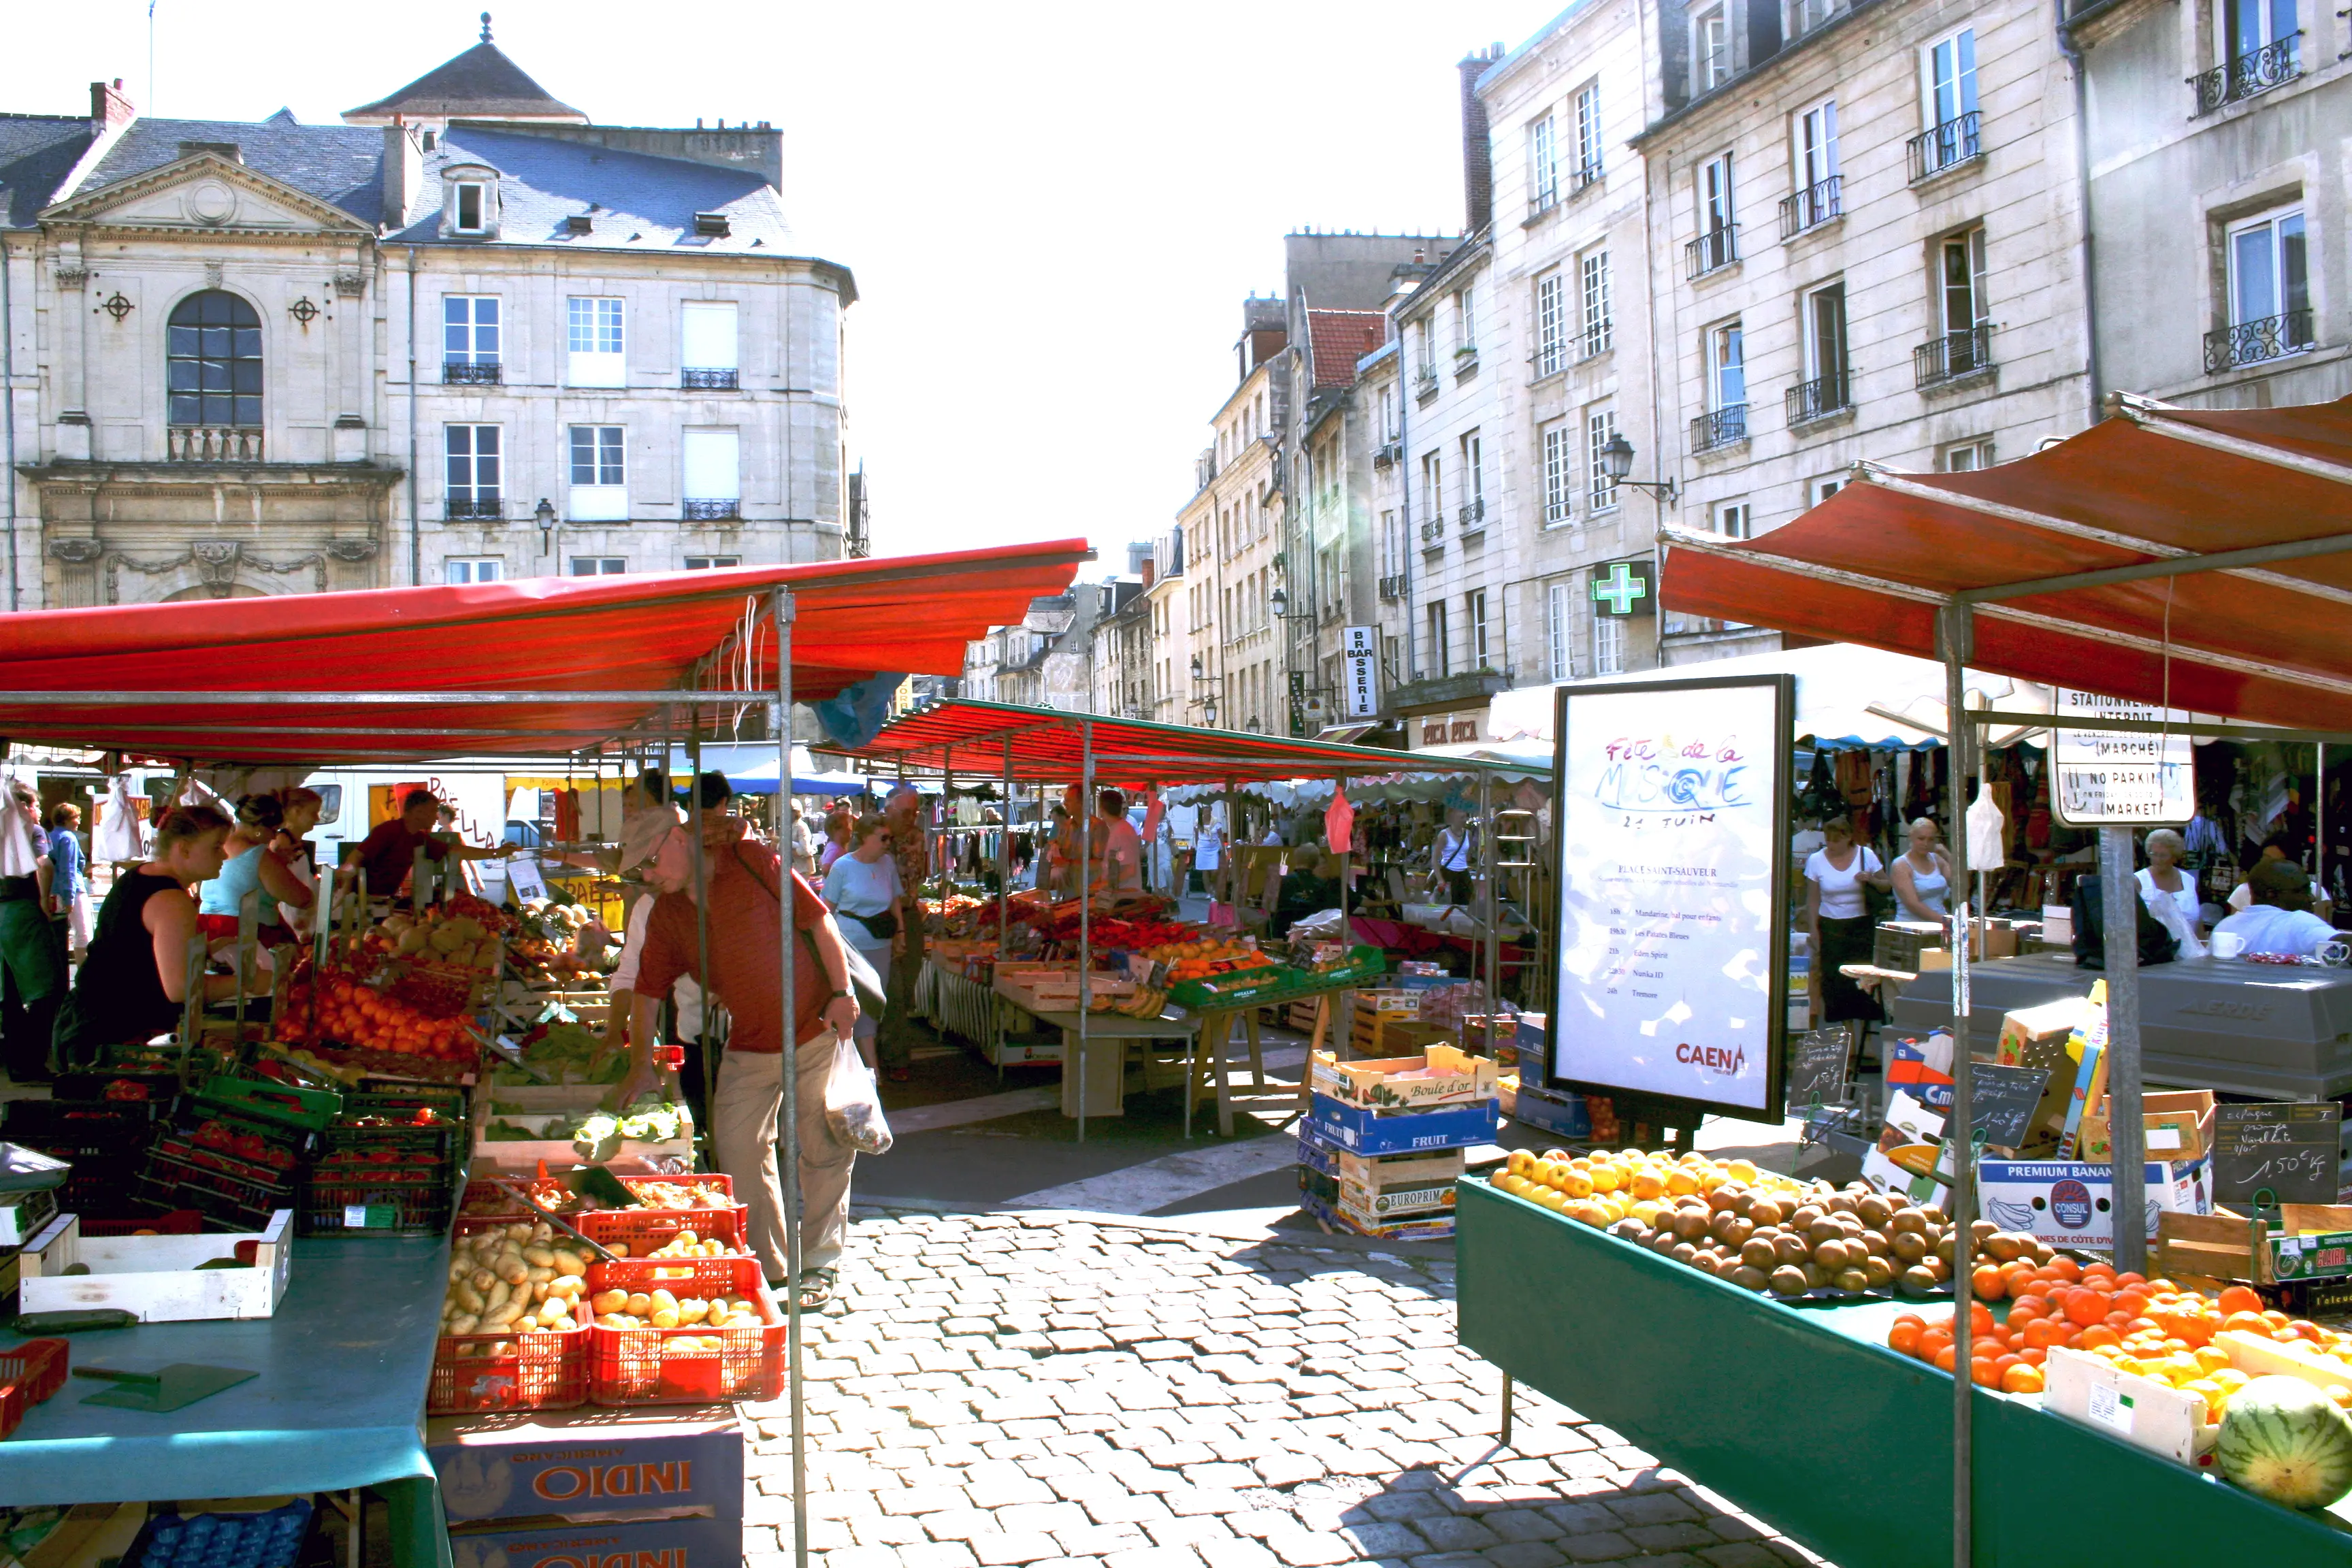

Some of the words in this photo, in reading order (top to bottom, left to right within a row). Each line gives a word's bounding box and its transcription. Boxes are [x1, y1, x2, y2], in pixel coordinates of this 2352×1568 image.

[1348, 649, 1373, 657] BAR
[1354, 631, 1368, 713] BRASSERIE
[1423, 723, 1448, 745] PICA
[1451, 721, 1478, 742] PICA
[1682, 739, 1712, 759] de
[1716, 735, 1744, 763] la
[2095, 740, 2159, 756] (MARCHÉ)
[2090, 772, 2106, 784] NO
[1595, 764, 1748, 808] MUSIQUE
[1618, 865, 1645, 875] PLACE
[1647, 866, 1718, 877] SAINT-SAUVEUR
[1698, 913, 1722, 921] enfants
[1635, 929, 1645, 937] Les
[1646, 930, 1668, 938] Patates
[1634, 949, 1649, 958] Eden
[1650, 951, 1668, 960] Spirit
[1676, 1043, 1732, 1068] CAEN
[1410, 1083, 1445, 1097] Boule
[1447, 1079, 1470, 1093] d'or
[1324, 1122, 1343, 1138] FRUIT
[1413, 1134, 1448, 1147] FRUIT
[2008, 1166, 2068, 1177] PREMIUM
[1390, 1189, 1440, 1207] EUROPRIM
[2055, 1203, 2088, 1214] CONSUL
[2036, 1234, 2056, 1244] ANES
[2057, 1236, 2069, 1244] DE
[2071, 1232, 2095, 1245] CÔTE
[512, 1448, 626, 1463] AMERICANO
[532, 1460, 692, 1501] INDIO
